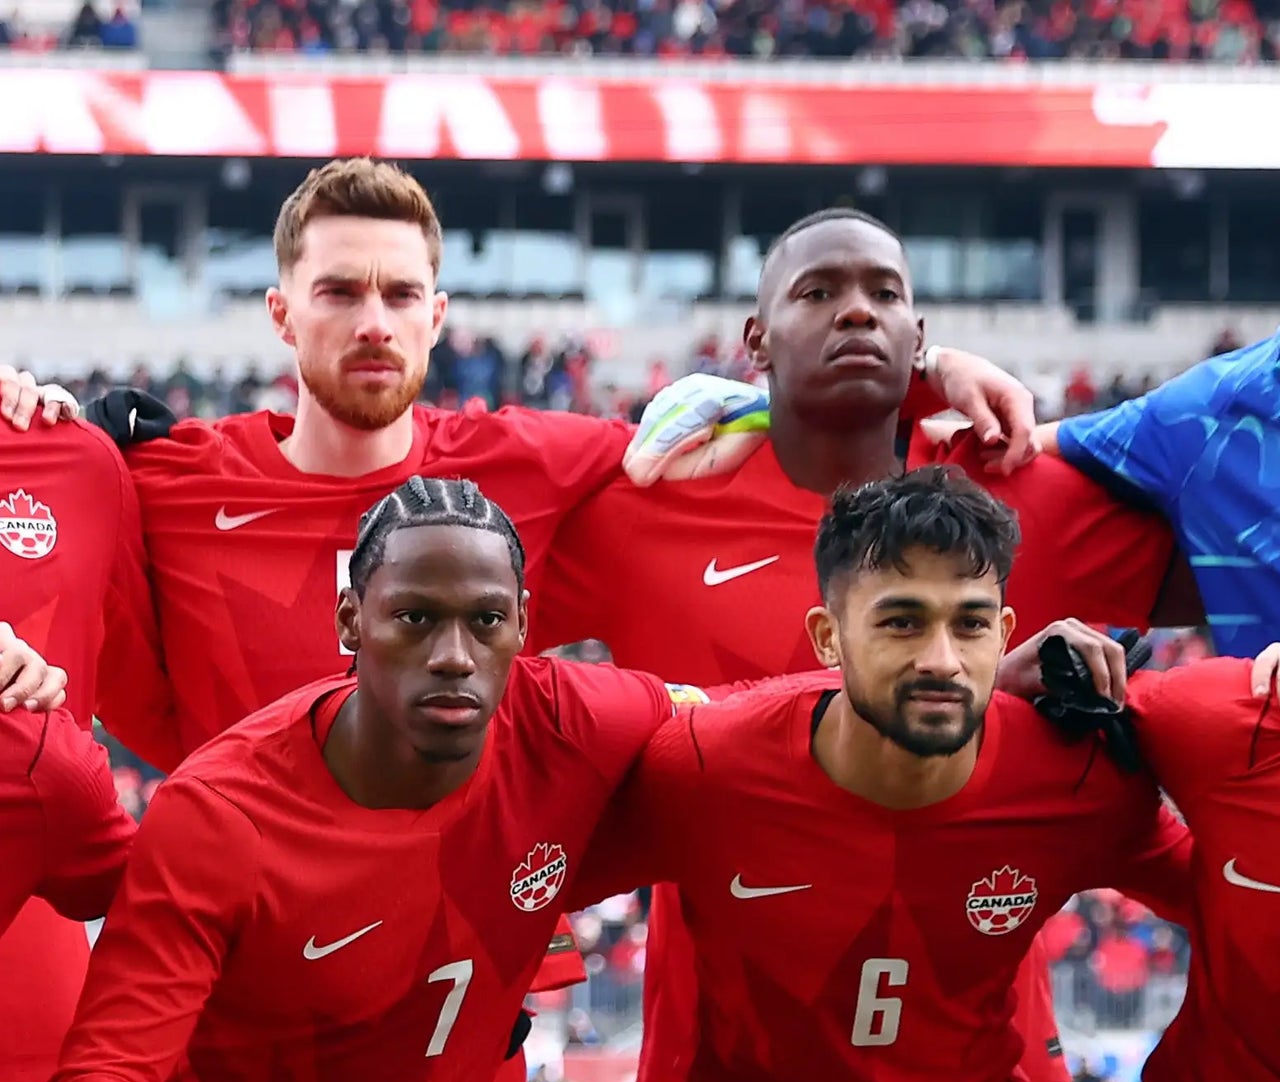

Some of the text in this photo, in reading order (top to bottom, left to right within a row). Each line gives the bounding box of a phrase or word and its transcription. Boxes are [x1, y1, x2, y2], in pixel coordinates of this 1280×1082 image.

[511, 860, 564, 895] CANADA
[968, 895, 1035, 910] CANADA
[425, 958, 474, 1057] 7
[851, 958, 909, 1046] 6
